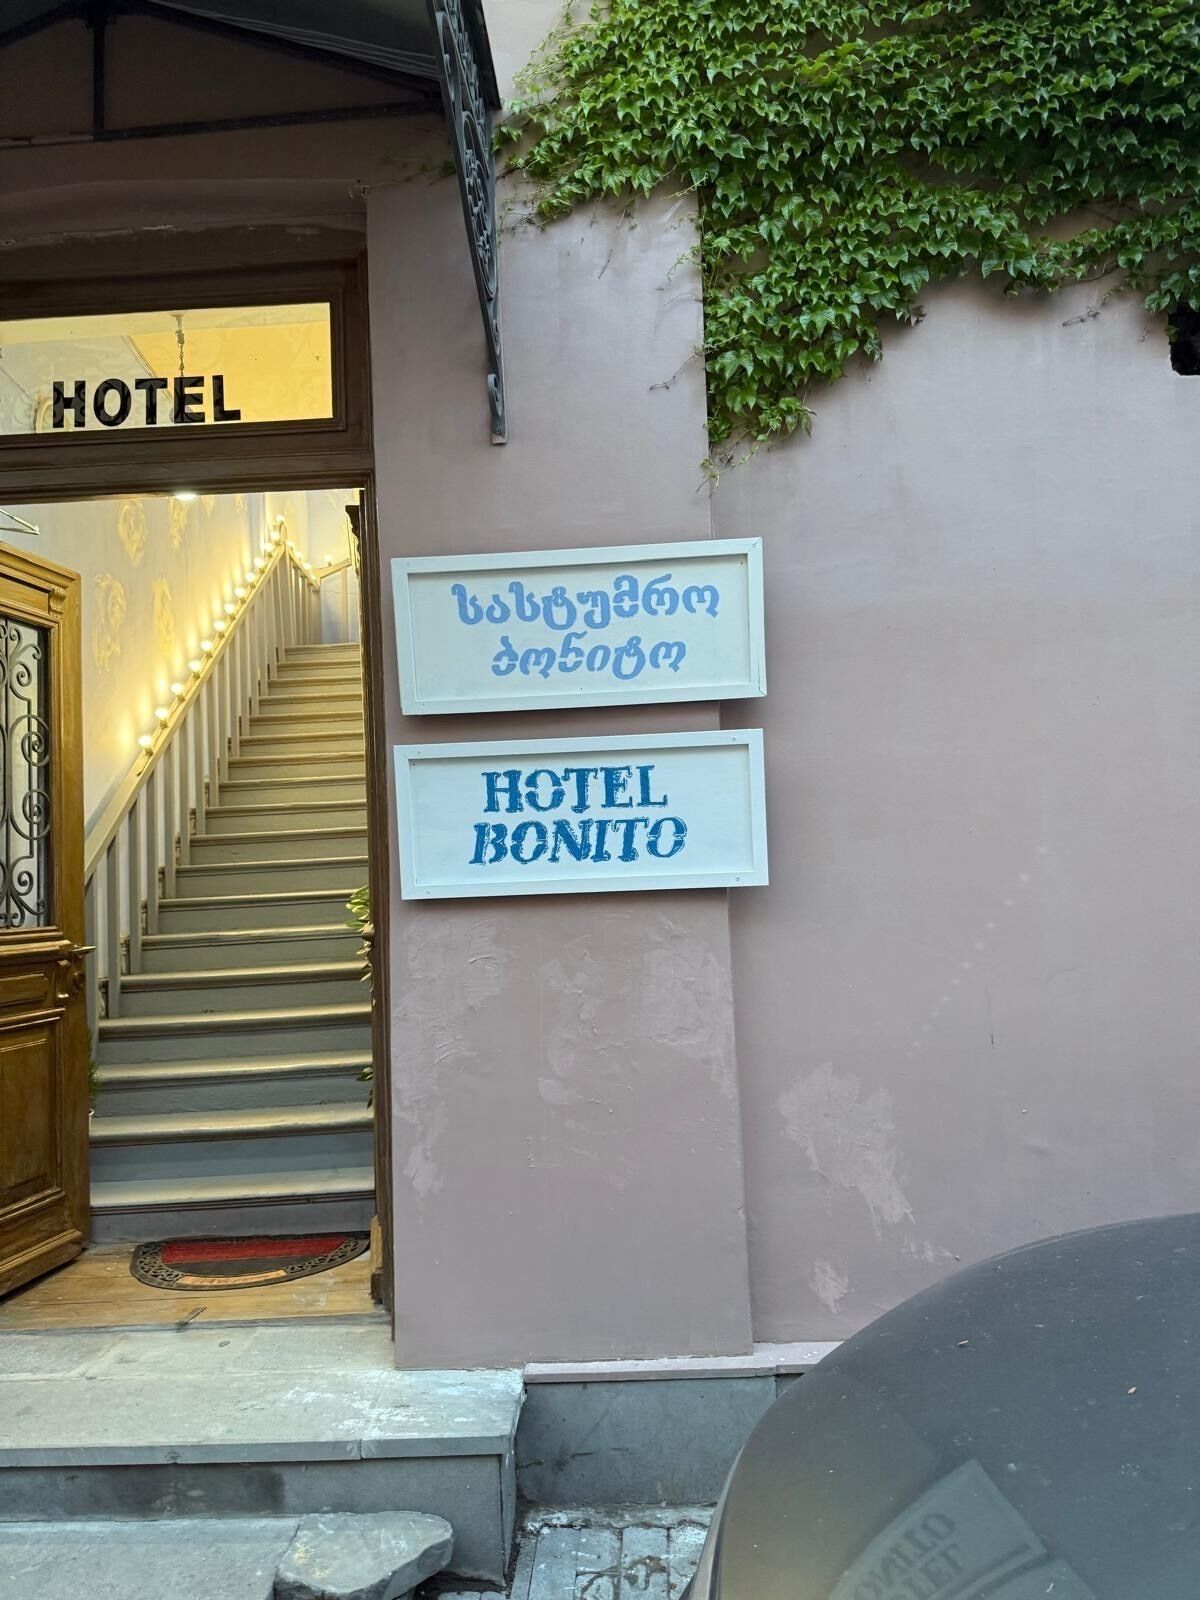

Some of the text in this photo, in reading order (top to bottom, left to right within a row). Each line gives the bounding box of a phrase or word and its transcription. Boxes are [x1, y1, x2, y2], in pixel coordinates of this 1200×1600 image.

[52, 375, 241, 428] HOTEL
[451, 574, 720, 630] სასტუმრო
[491, 631, 687, 680] ბონიტო
[481, 764, 668, 813] HOTEL
[468, 816, 688, 865] BONITO
